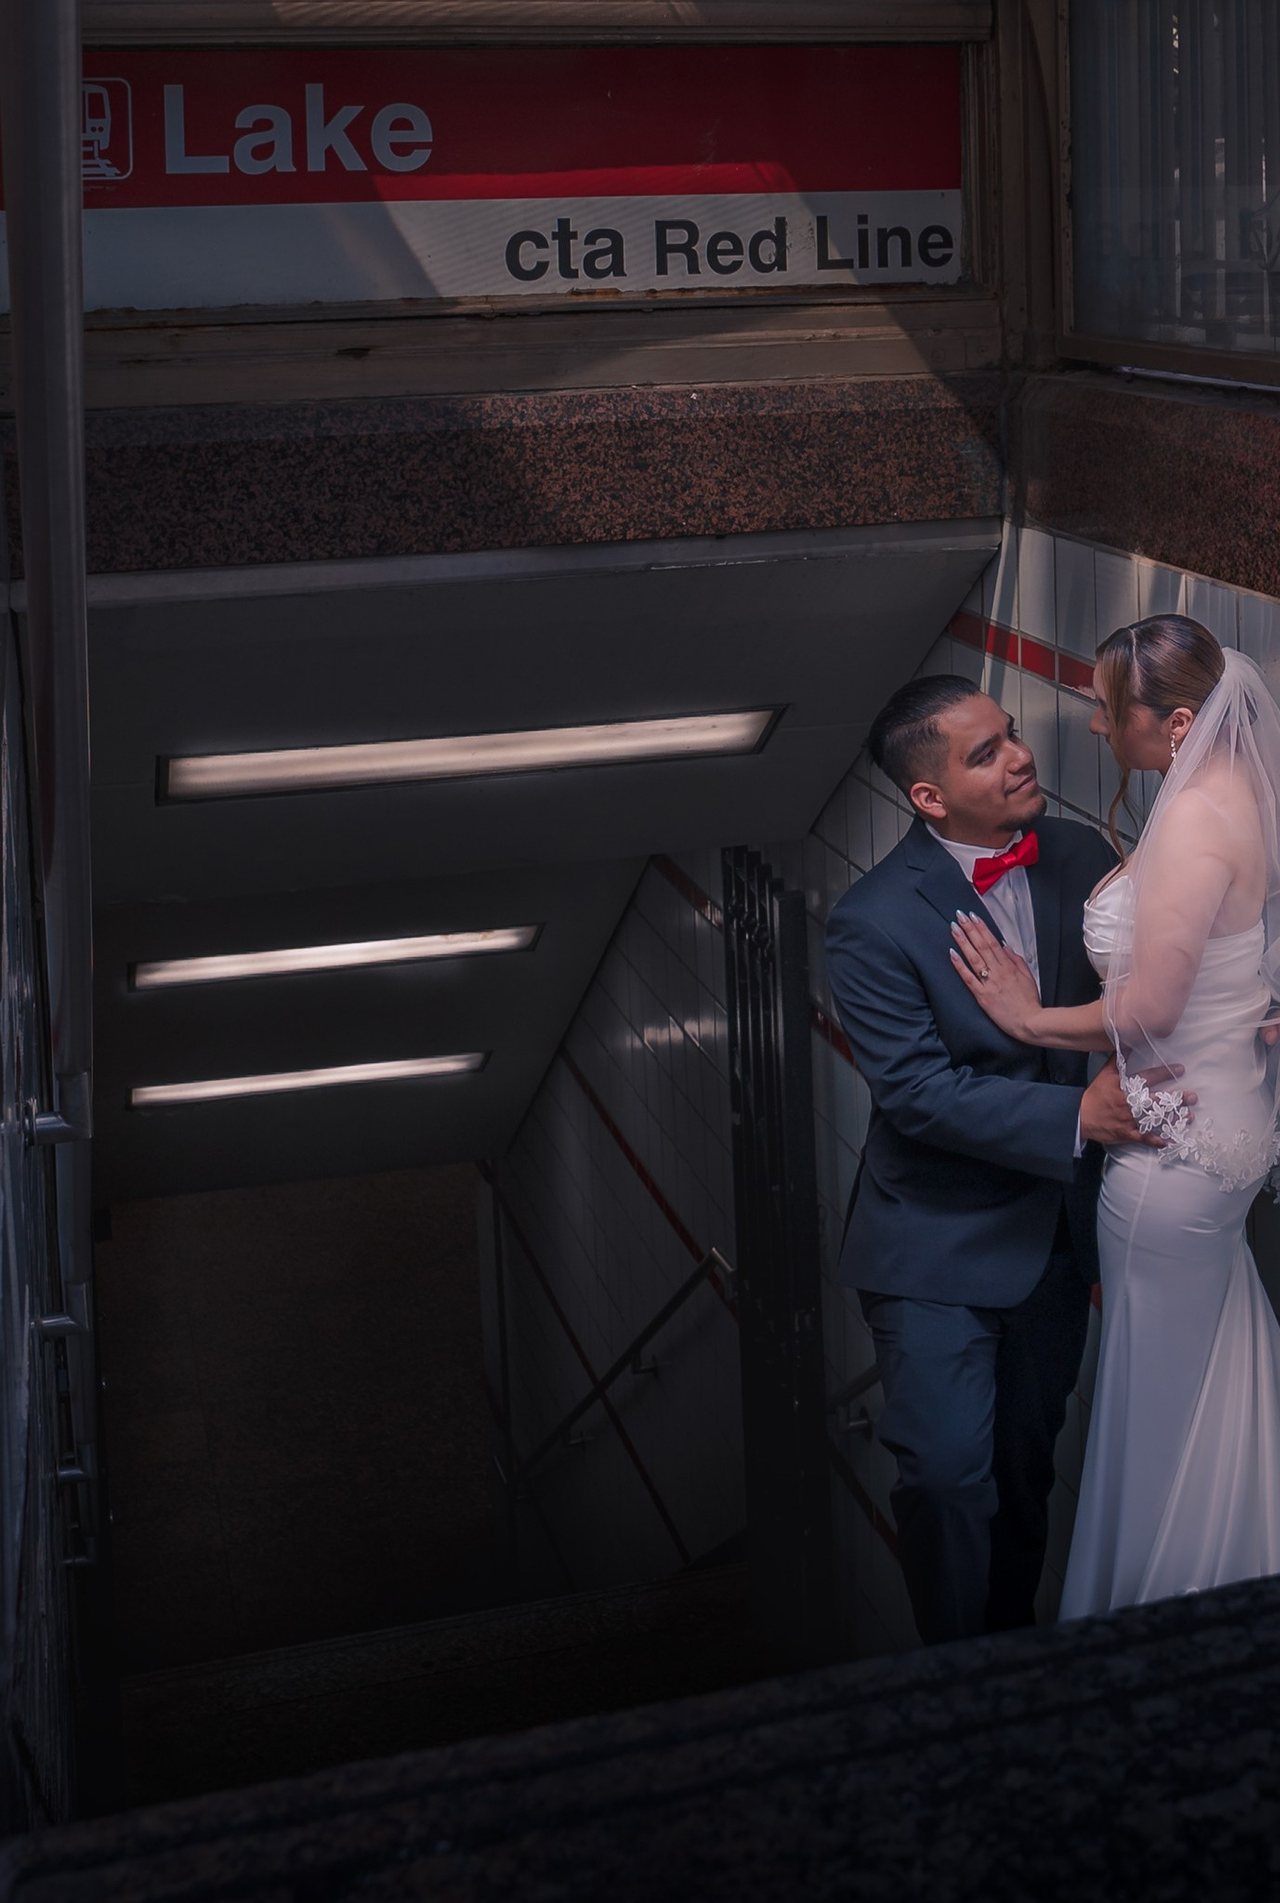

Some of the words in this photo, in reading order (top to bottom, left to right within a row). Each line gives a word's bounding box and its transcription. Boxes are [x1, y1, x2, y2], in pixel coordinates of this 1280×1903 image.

[164, 82, 434, 177] Lake
[505, 217, 627, 282] cta
[655, 216, 788, 277] Red
[817, 214, 954, 273] Line
